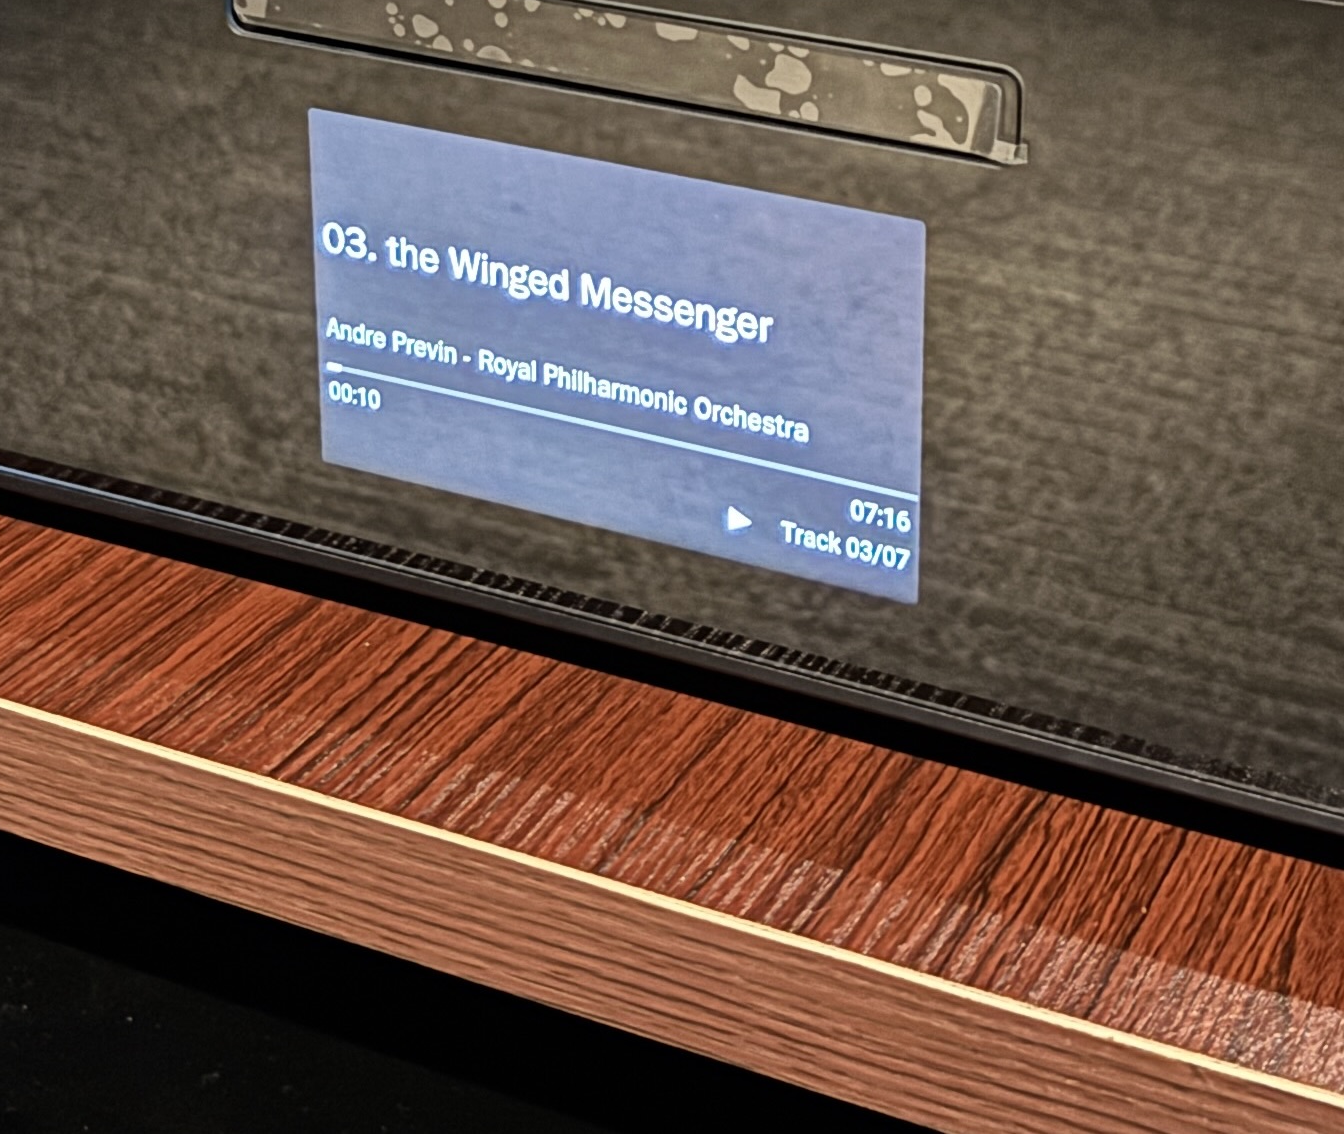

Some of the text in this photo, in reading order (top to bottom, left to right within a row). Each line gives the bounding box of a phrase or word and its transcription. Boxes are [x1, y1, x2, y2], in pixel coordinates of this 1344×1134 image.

[322, 221, 775, 344] 03. the Winged Messenger
[325, 316, 811, 444] Andre Previn - Royal Philharmonic Orchestra
[328, 380, 381, 411] 00:10
[849, 498, 912, 533] 07:16
[779, 519, 912, 571] Track 03/07
